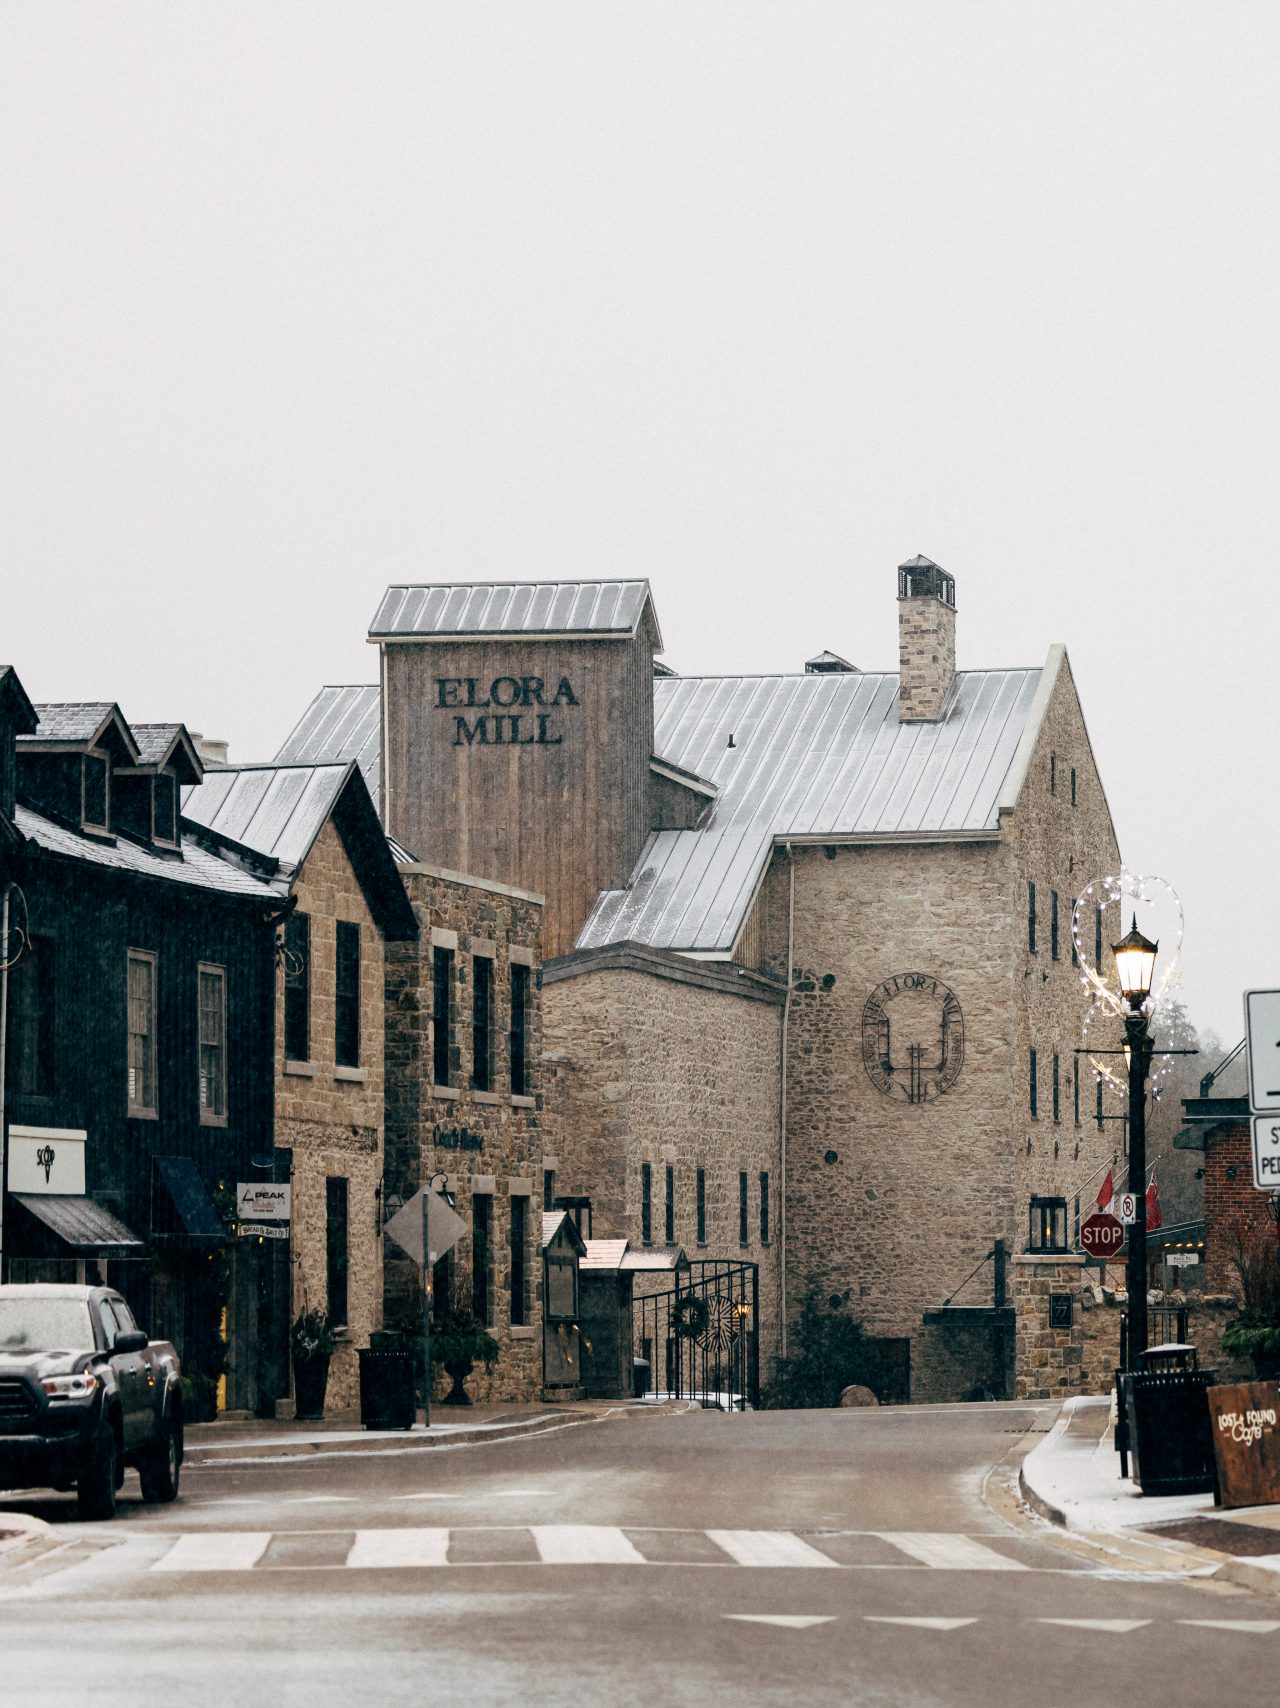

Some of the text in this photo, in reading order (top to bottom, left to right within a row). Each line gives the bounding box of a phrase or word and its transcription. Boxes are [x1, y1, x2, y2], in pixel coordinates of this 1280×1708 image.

[434, 675, 580, 708] ELORA
[453, 714, 563, 746] MILL
[883, 975, 937, 997] ELORA
[254, 1191, 285, 1199] PEAK
[243, 1226, 260, 1235] BREAD
[265, 1228, 278, 1236] SALT
[1083, 1226, 1122, 1243] STOP
[1217, 1412, 1237, 1431] LOST
[1246, 1408, 1277, 1426] FOUND
